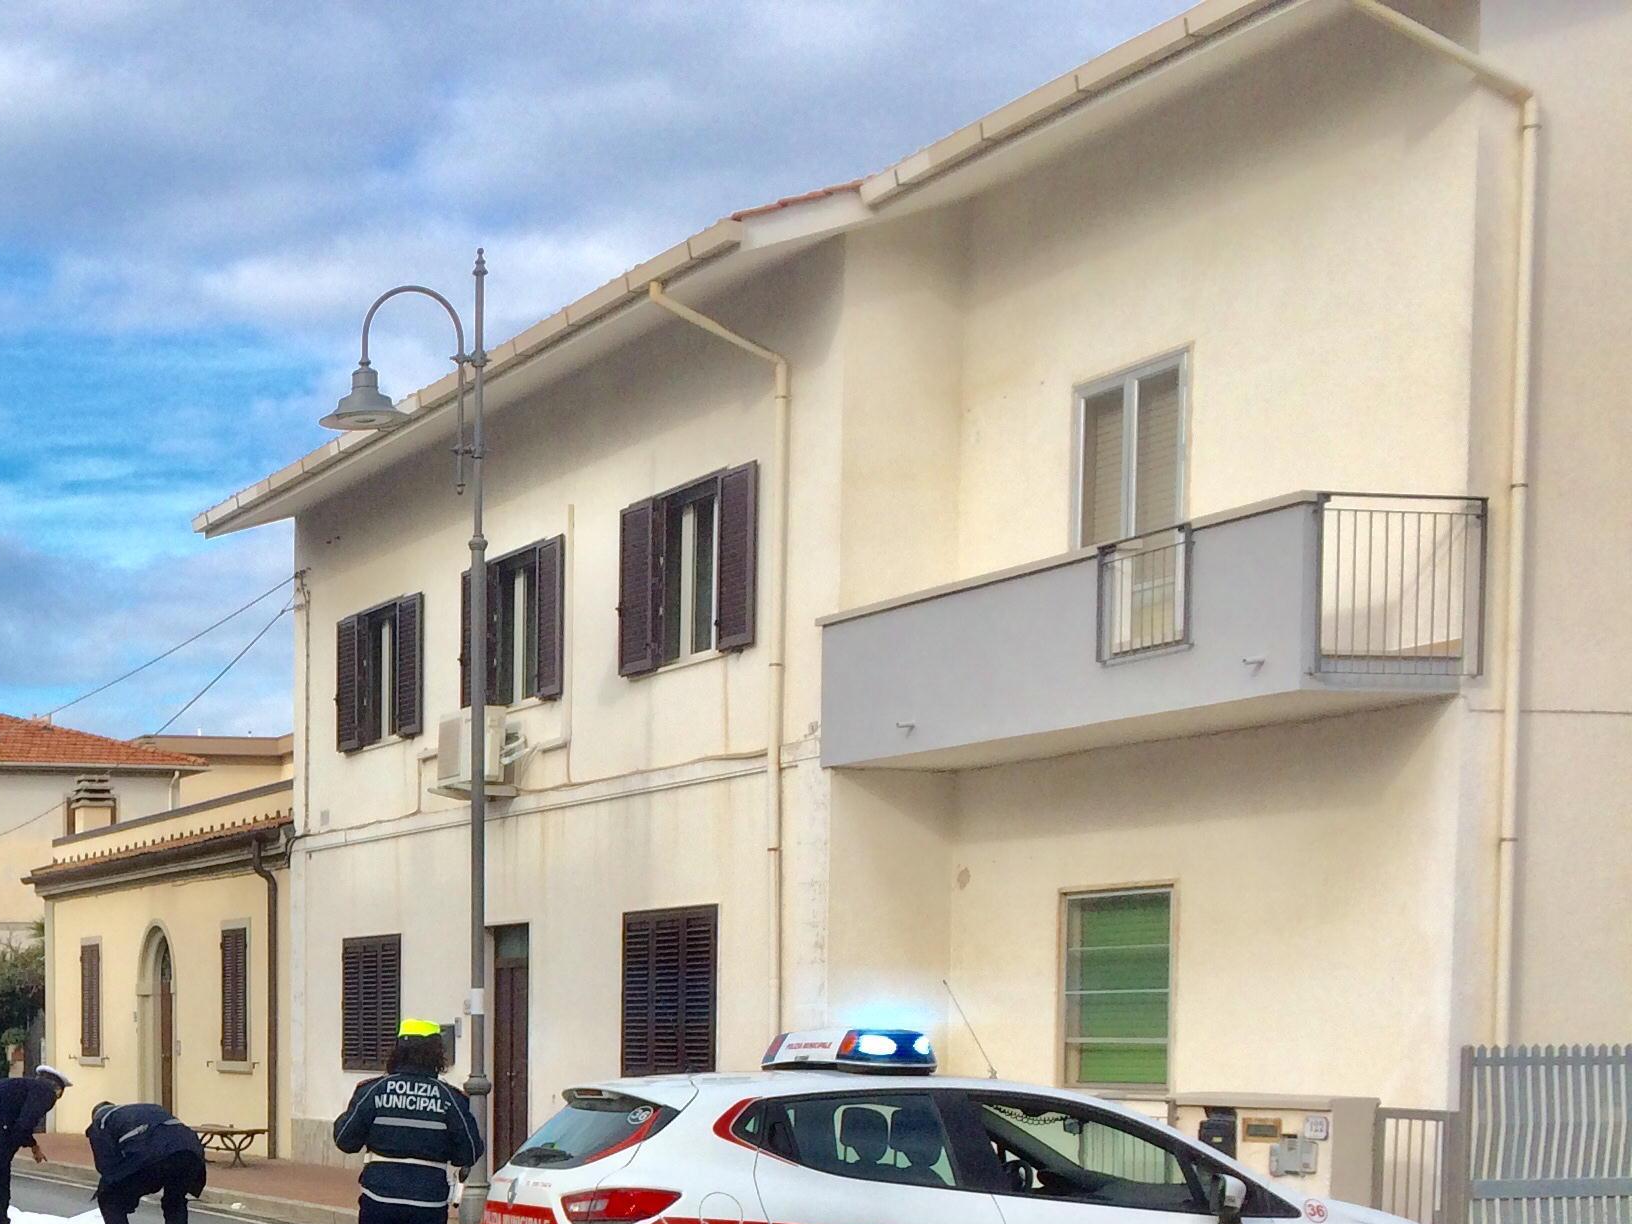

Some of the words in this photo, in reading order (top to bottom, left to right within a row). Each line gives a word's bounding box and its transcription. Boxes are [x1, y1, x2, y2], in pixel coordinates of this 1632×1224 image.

[387, 1081, 440, 1098] POLIZIA
[374, 1094, 451, 1114] MUNICIPALE
[630, 1109, 651, 1121] 36
[1307, 1203, 1325, 1218] 36
